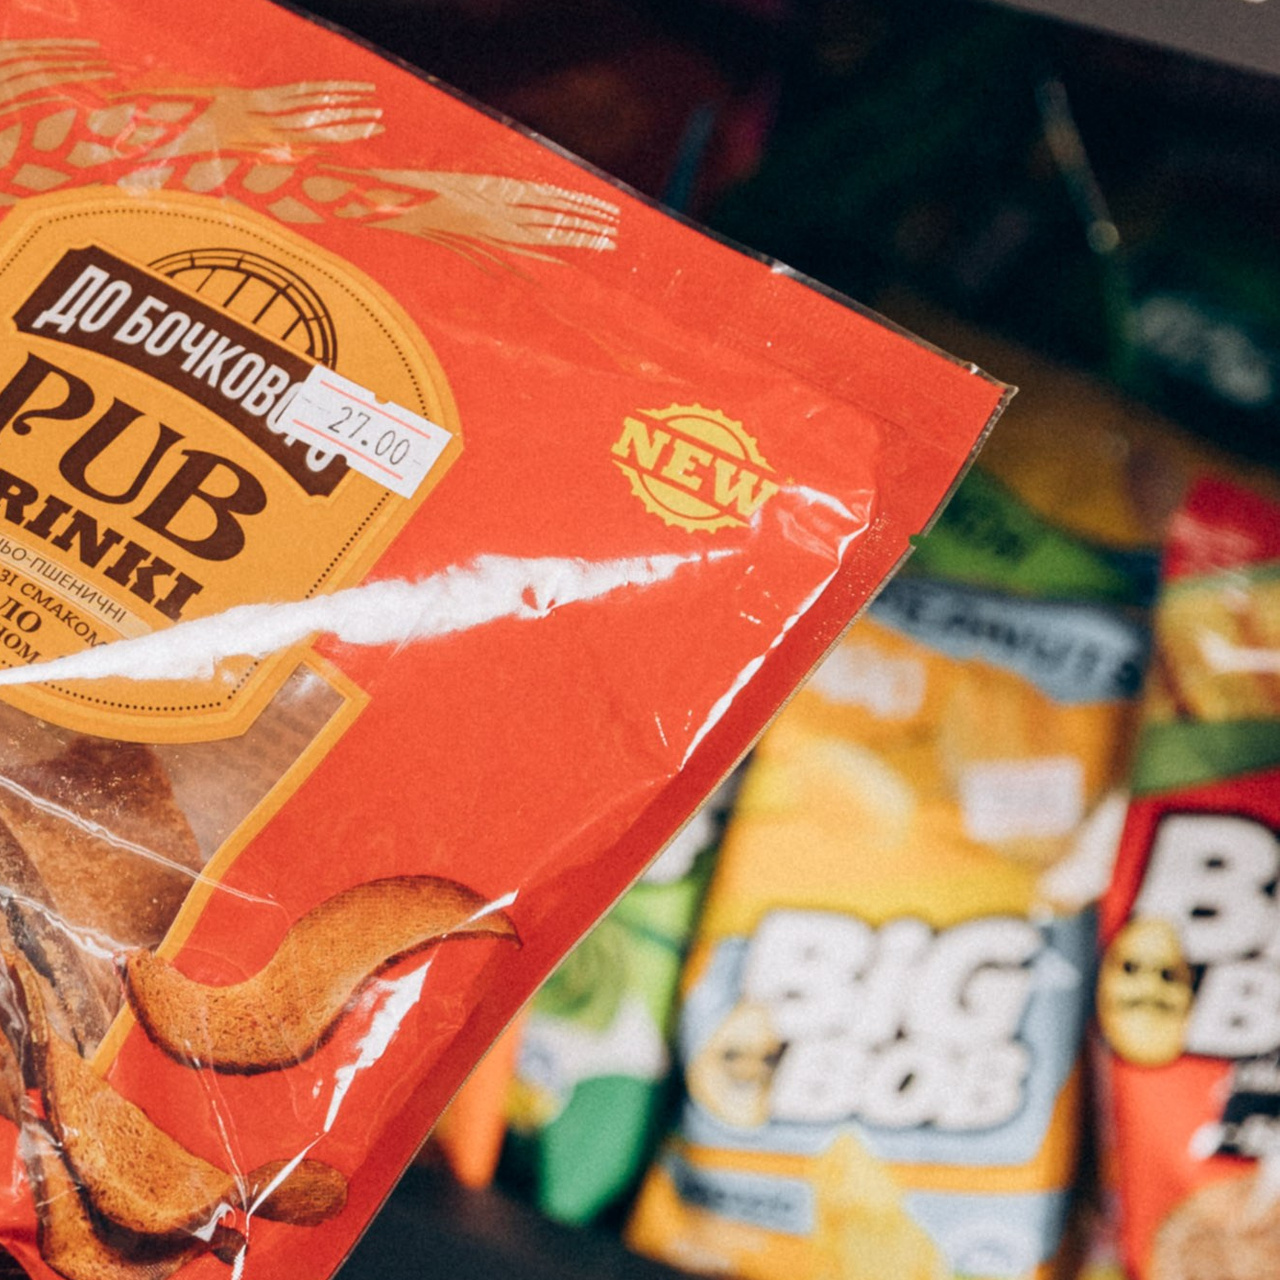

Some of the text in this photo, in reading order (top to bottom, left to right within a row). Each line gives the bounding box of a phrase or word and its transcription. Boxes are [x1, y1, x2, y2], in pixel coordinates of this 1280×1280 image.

[31, 263, 339, 473] ДО БОЧКОВО
[327, 406, 411, 466] 27.00
[611, 416, 780, 517] NEW
[20, 582, 109, 649] СМАКОМ
[743, 907, 1044, 1042] BIG
[766, 1034, 1032, 1132] BOB
